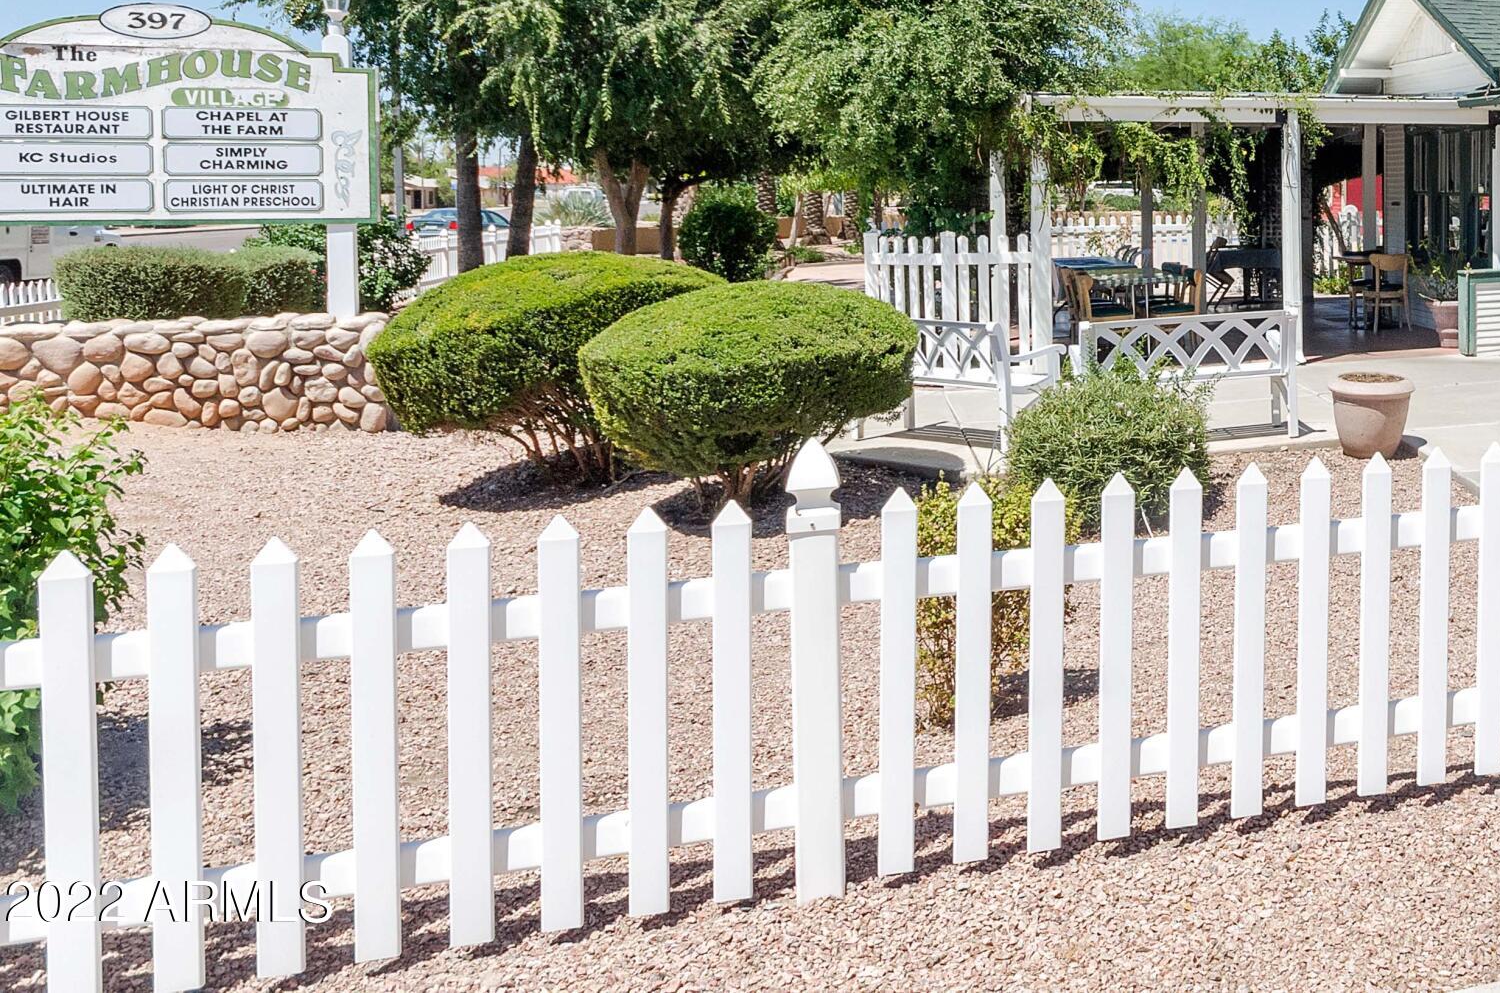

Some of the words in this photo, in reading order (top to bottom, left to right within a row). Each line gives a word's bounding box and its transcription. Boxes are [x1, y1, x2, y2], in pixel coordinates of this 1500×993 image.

[127, 11, 187, 31] 397
[51, 45, 98, 62] The
[0, 49, 312, 101] FARMHOUSE
[184, 88, 285, 107] VILLAGE
[5, 110, 73, 122] GILBERT
[76, 110, 129, 122] HOUSE
[196, 111, 263, 123] CHAPEL
[268, 111, 289, 123] AT
[14, 123, 120, 135] RESTAURANT
[202, 124, 232, 136] THE
[237, 124, 284, 136] FARM
[19, 152, 44, 164] KC
[49, 152, 118, 164] Studios
[215, 147, 267, 158] SIMPLY
[199, 159, 289, 171] CHARMING
[20, 184, 95, 195] ULTIMATE
[100, 184, 117, 195] IN
[191, 184, 227, 195] LIGHT
[229, 184, 247, 195] OF
[251, 184, 296, 195] CHRIST
[49, 196, 90, 208] HAIR
[170, 196, 240, 208] CHRISTIAN
[243, 196, 317, 208] PRESCHOOL
